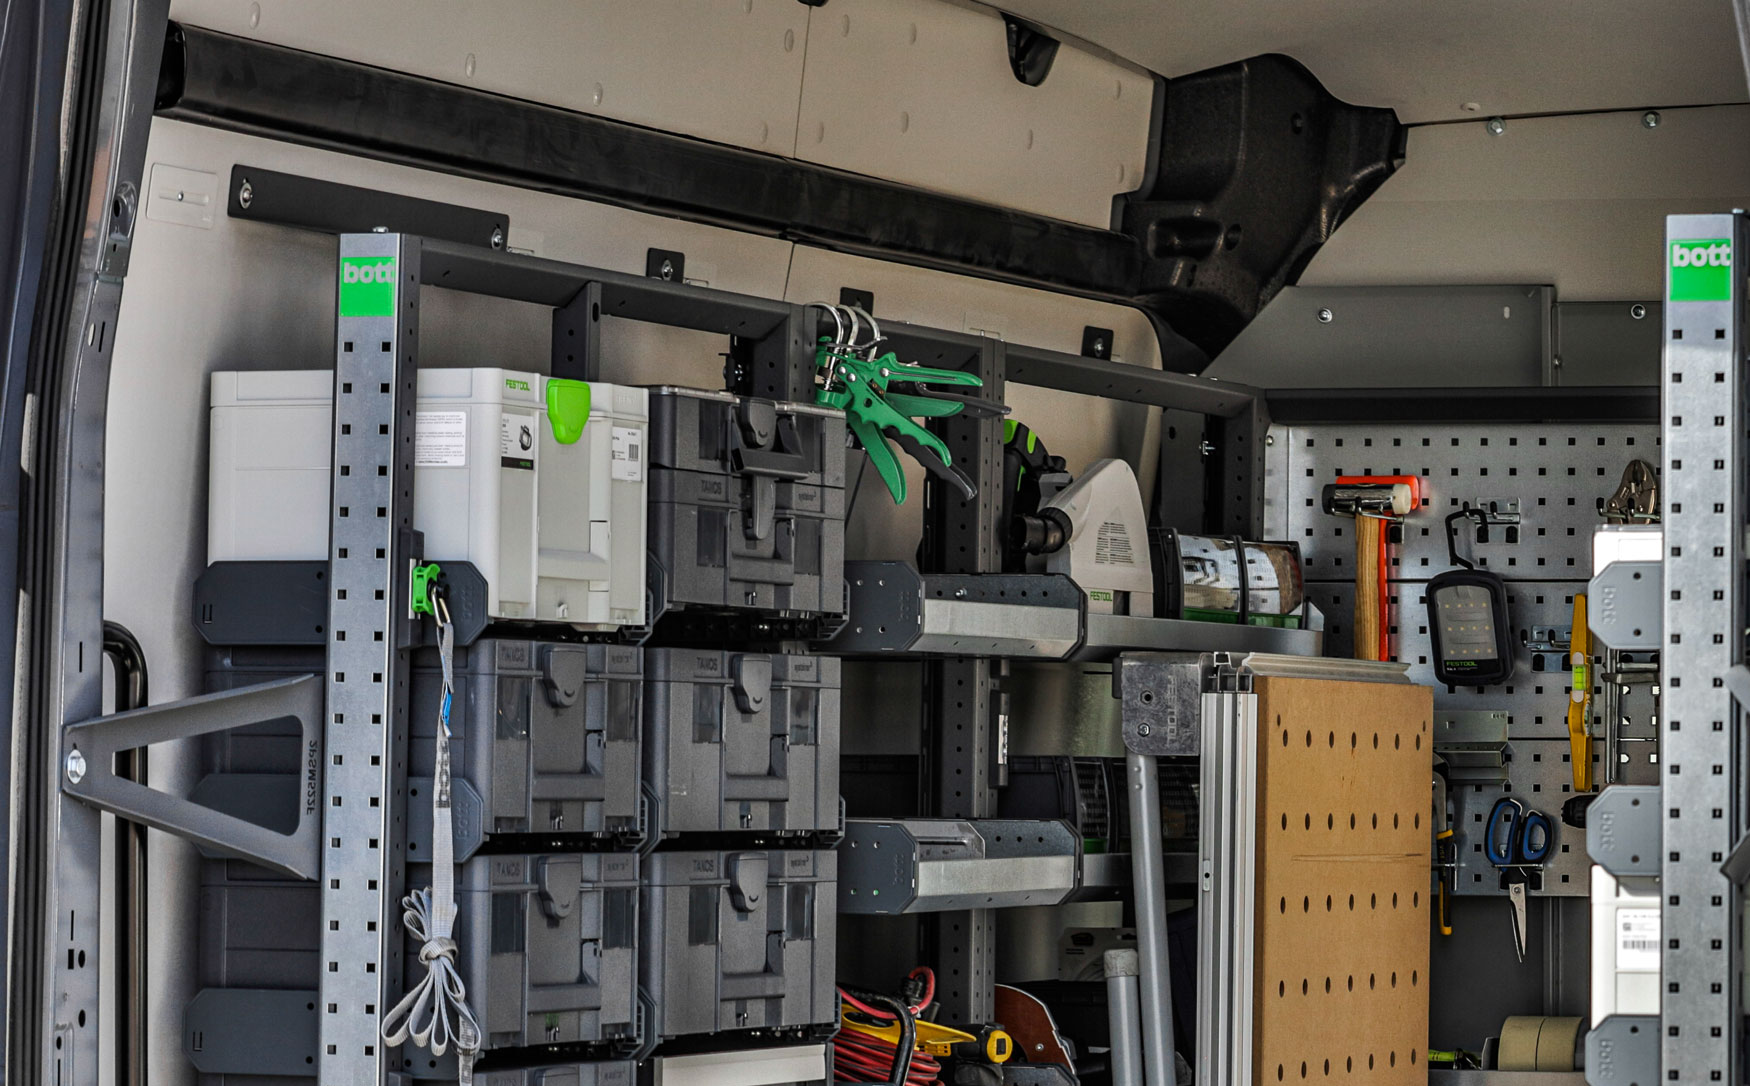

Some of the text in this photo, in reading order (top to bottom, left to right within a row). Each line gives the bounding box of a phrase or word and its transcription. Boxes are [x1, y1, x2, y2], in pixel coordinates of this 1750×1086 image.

[1673, 244, 1731, 268] bott
[343, 262, 395, 284] bott
[505, 379, 530, 391] FESTOOL
[1090, 590, 1113, 602] FESTOOL
